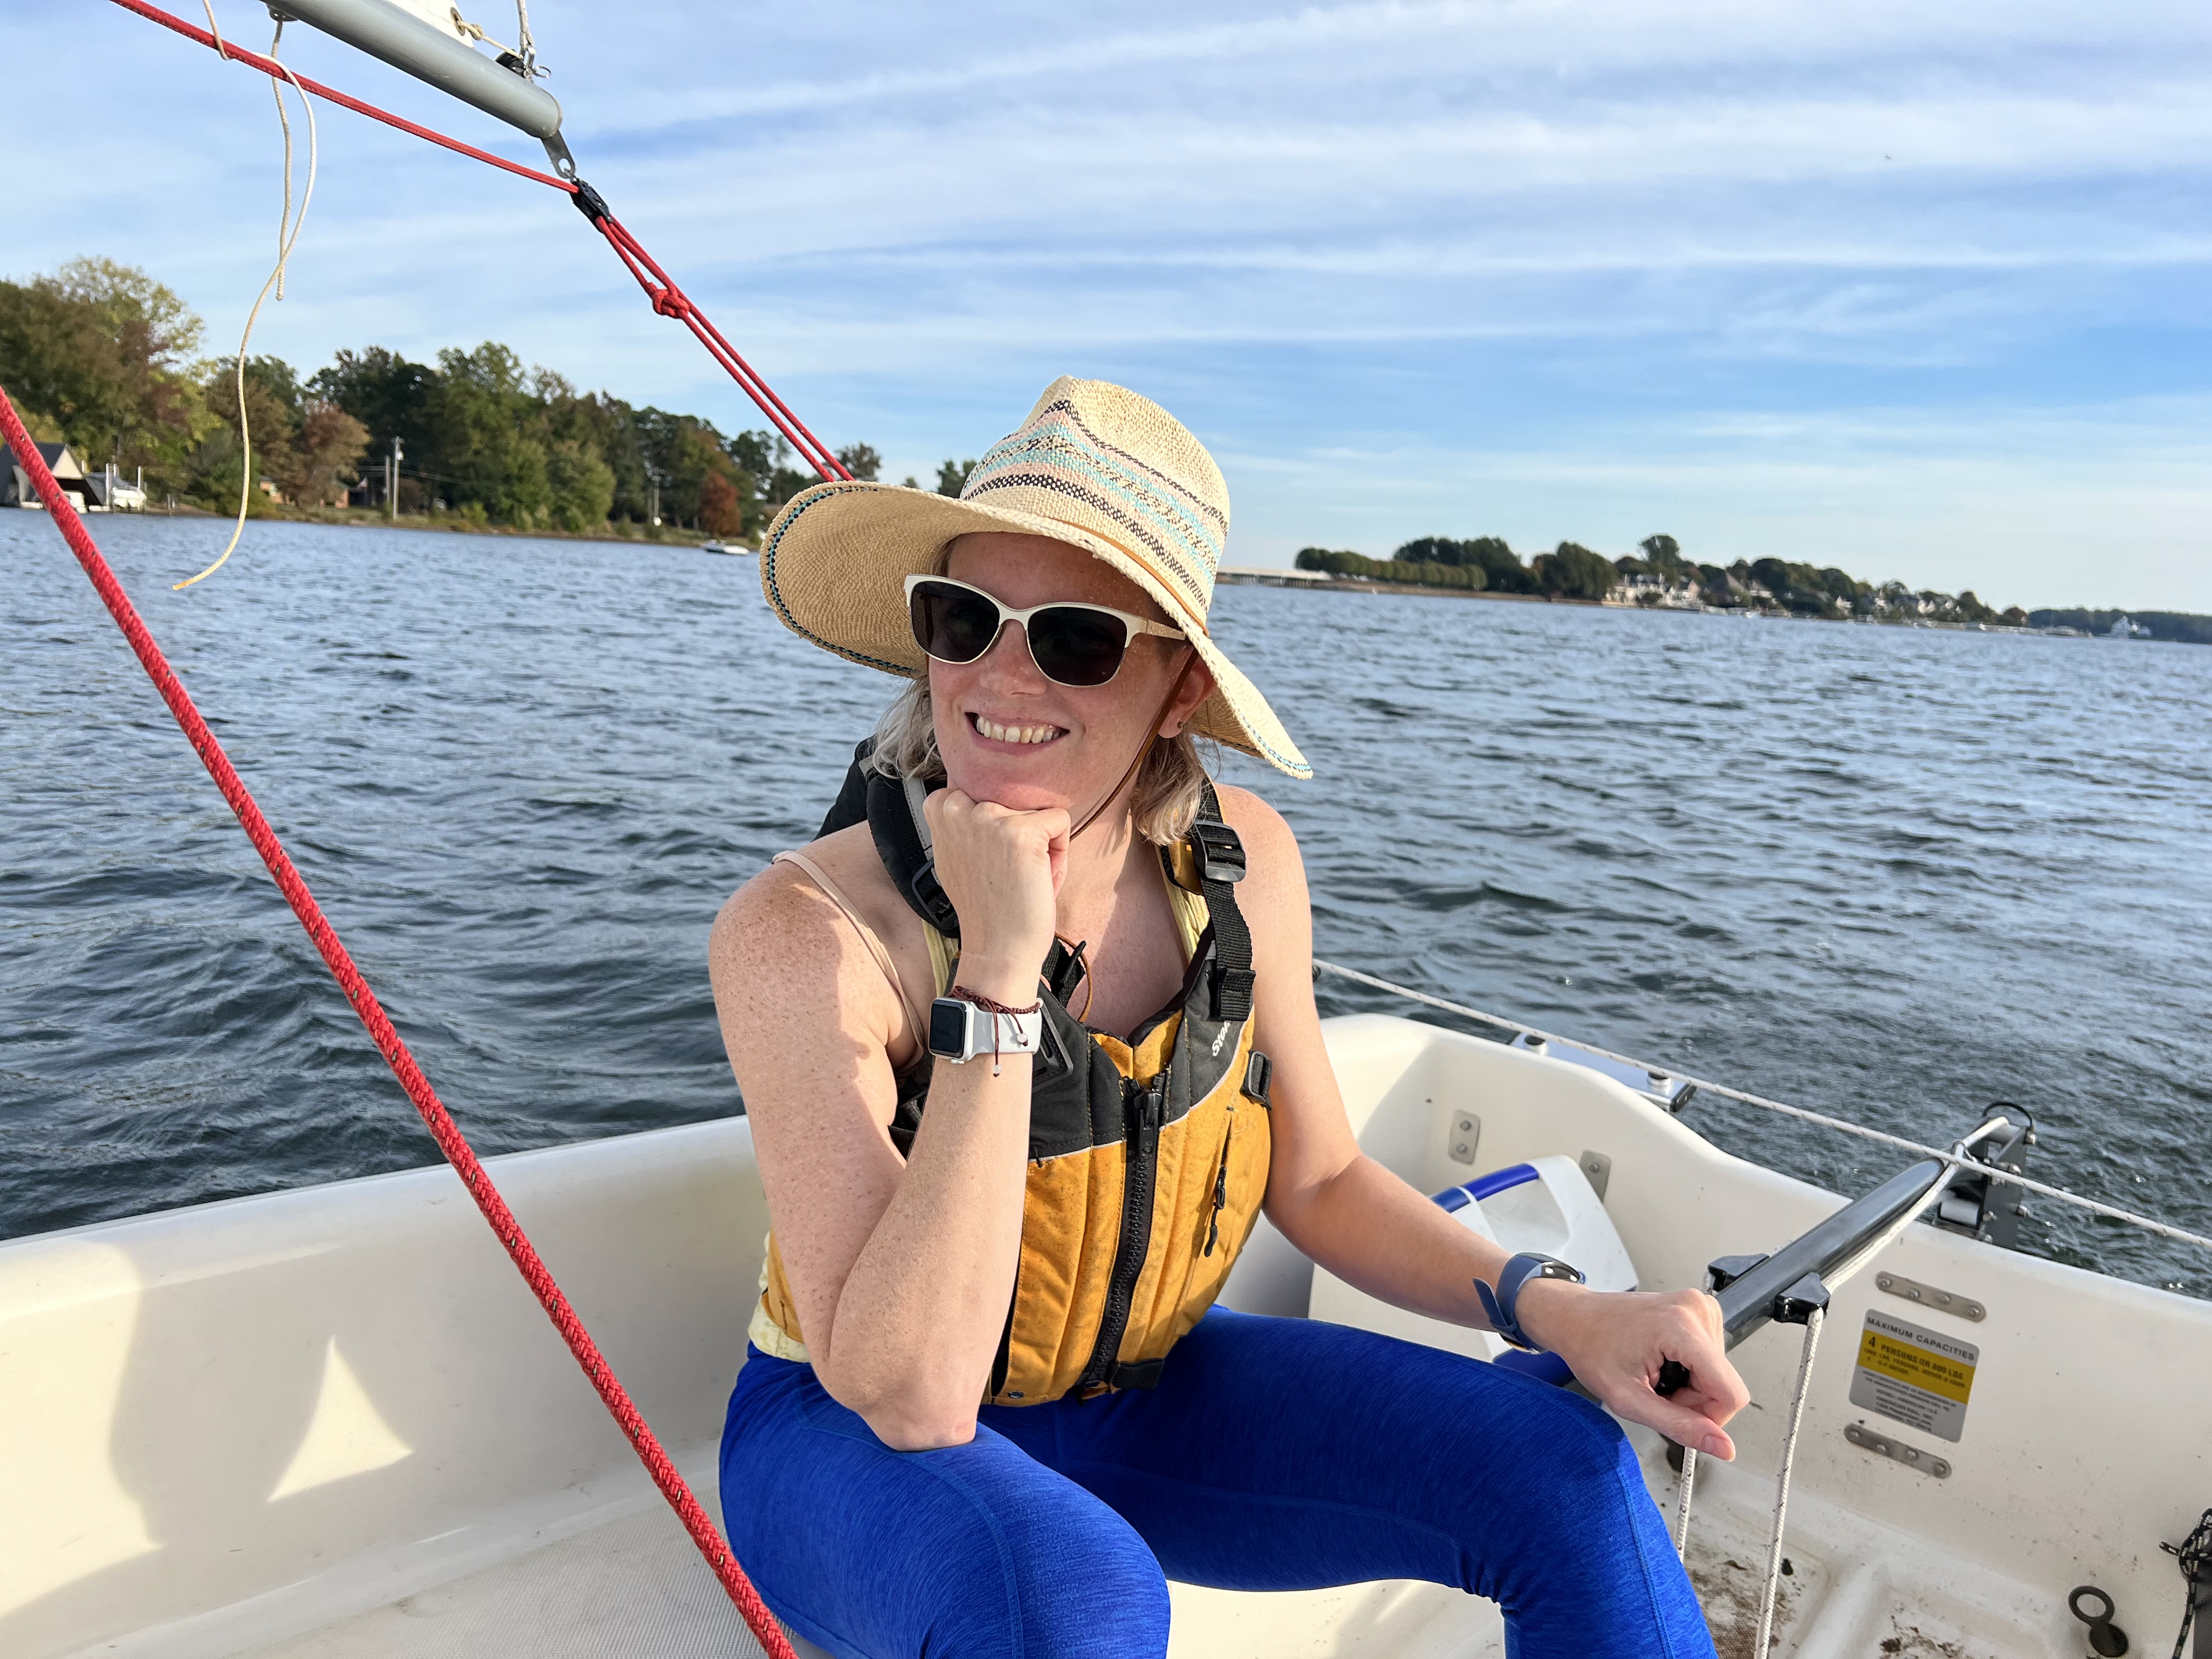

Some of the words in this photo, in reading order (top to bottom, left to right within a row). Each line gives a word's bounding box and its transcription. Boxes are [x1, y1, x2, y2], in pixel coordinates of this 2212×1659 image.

[1867, 1317, 1912, 1339] MAXIMUM
[1916, 1334, 1974, 1361] CAPACITIES
[1869, 1336, 1876, 1347] 4
[1881, 1344, 1917, 1362] PERSONS
[1919, 1358, 1931, 1368] OR
